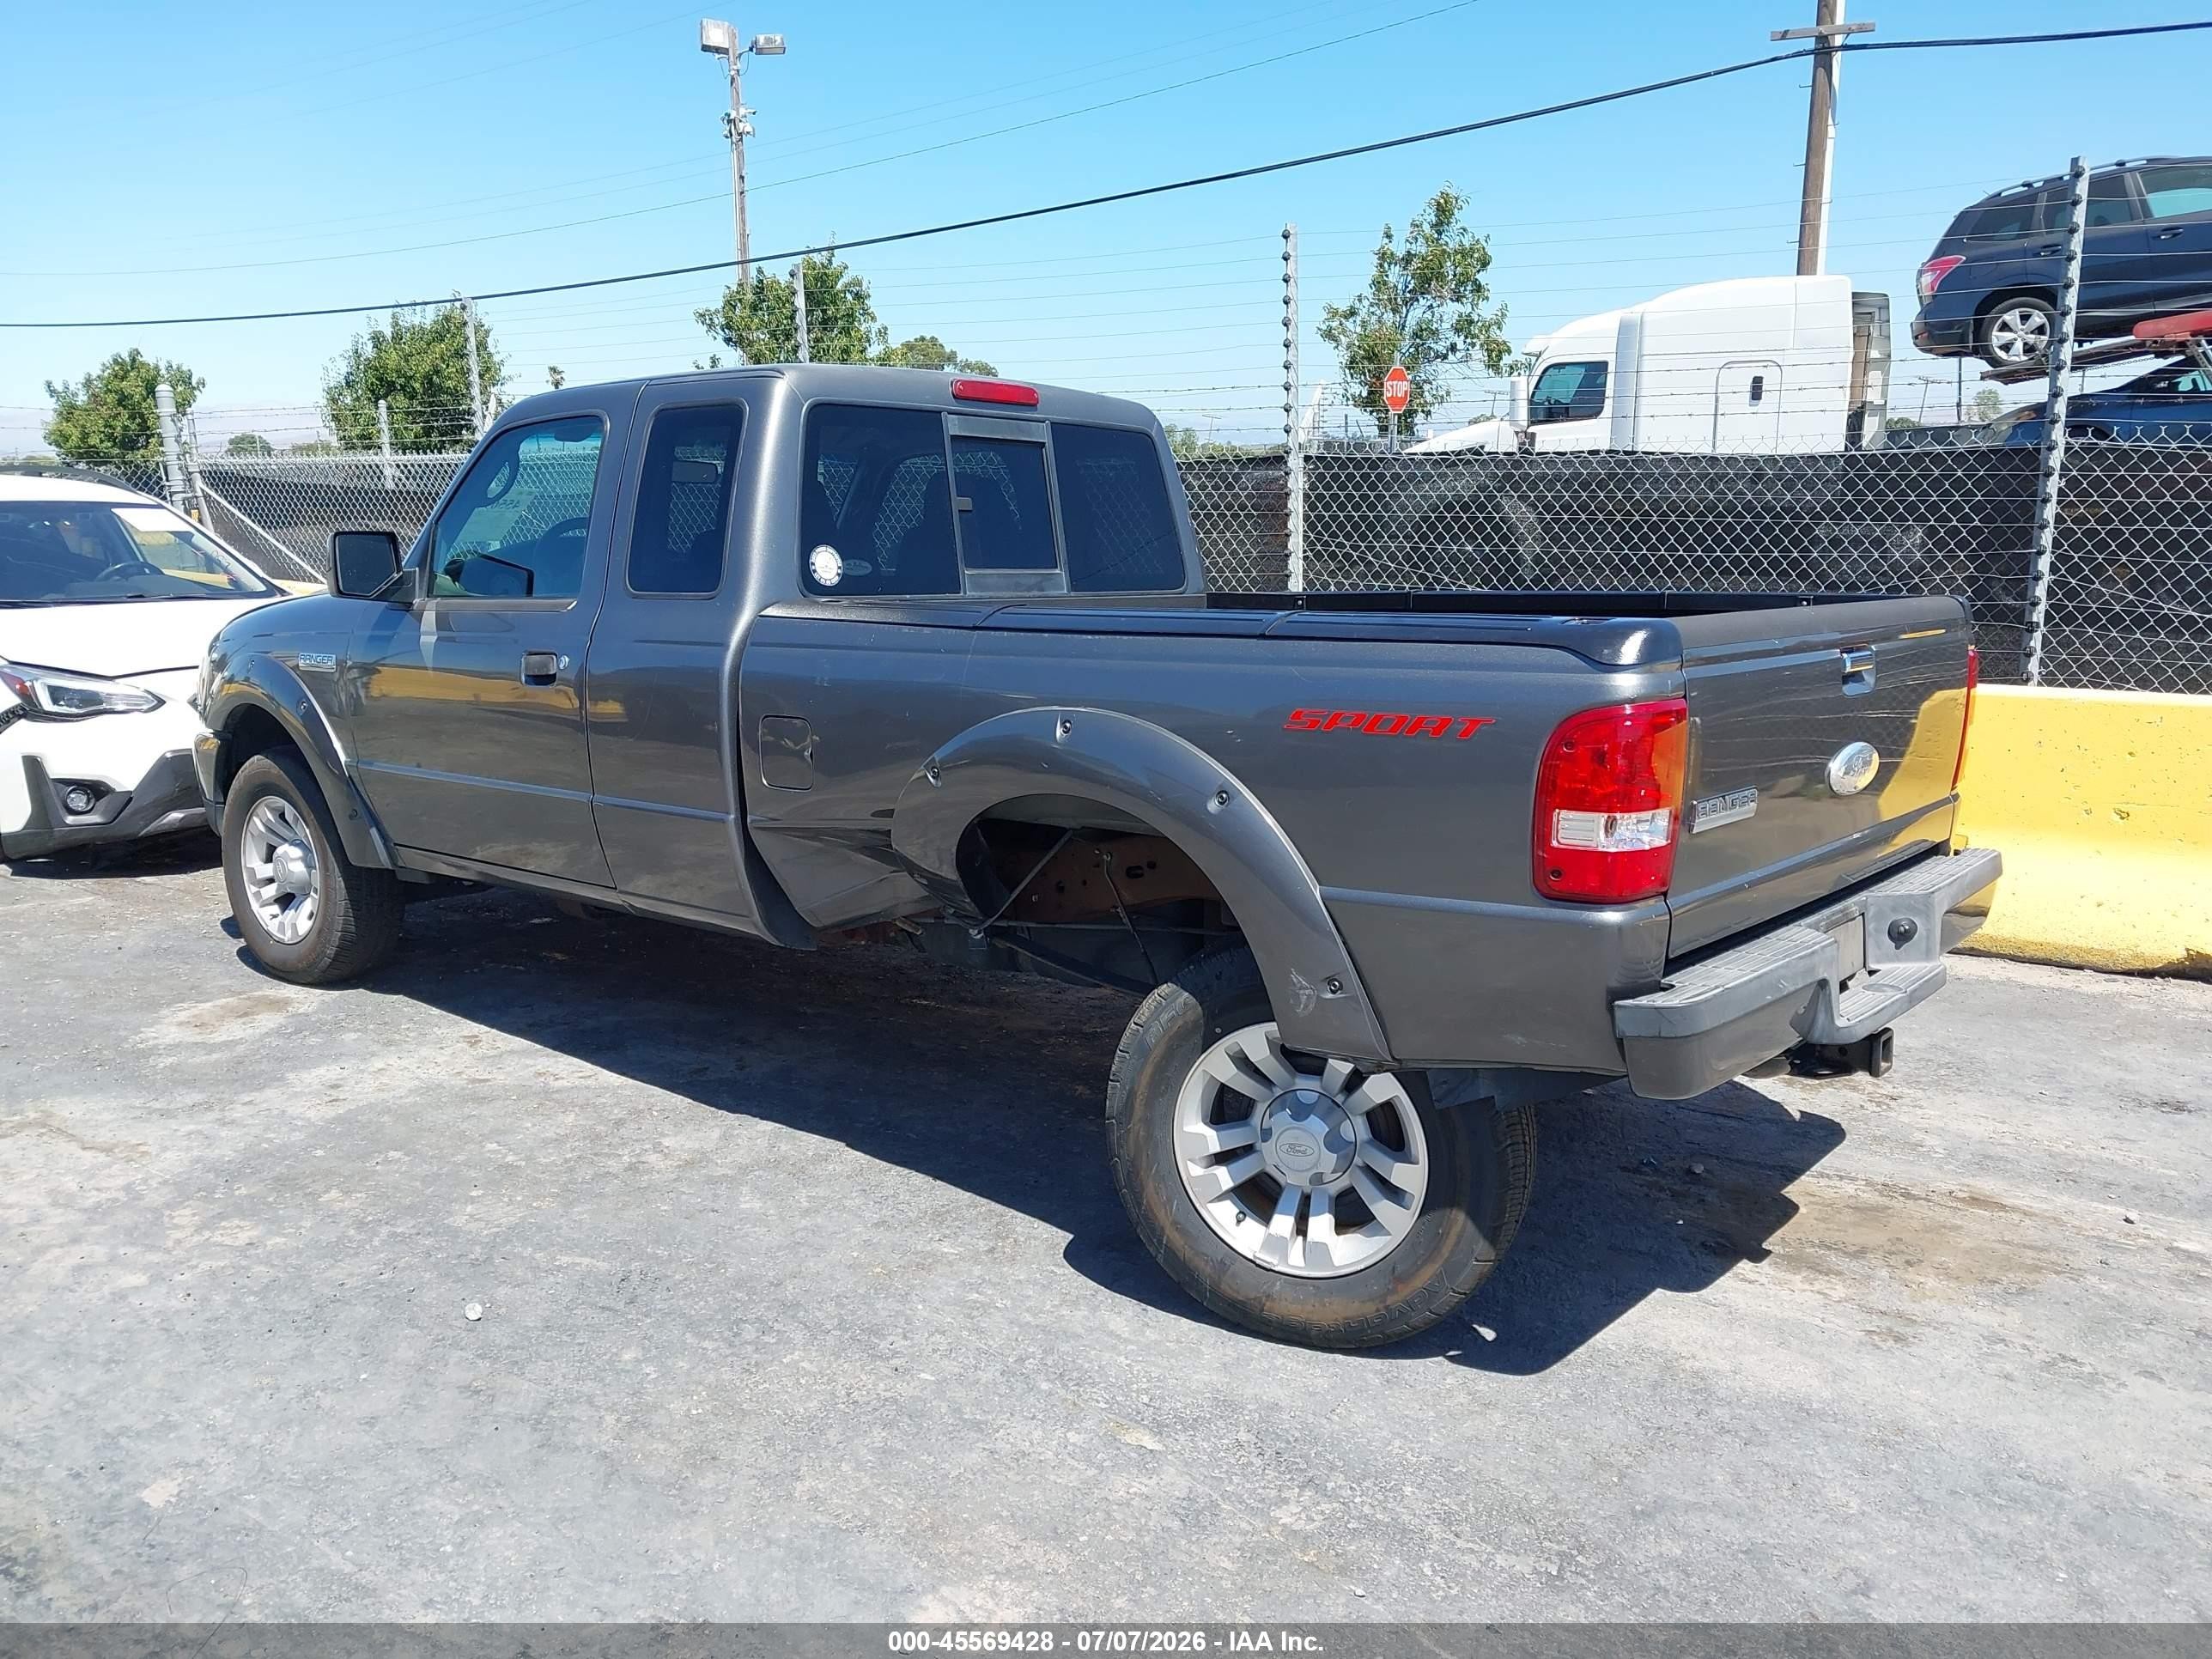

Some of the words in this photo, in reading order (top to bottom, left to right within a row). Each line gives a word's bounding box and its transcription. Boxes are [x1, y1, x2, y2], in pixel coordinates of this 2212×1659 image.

[1386, 380, 1408, 398] STOP
[300, 653, 334, 665] RANGER
[1284, 708, 1497, 740] SPORT
